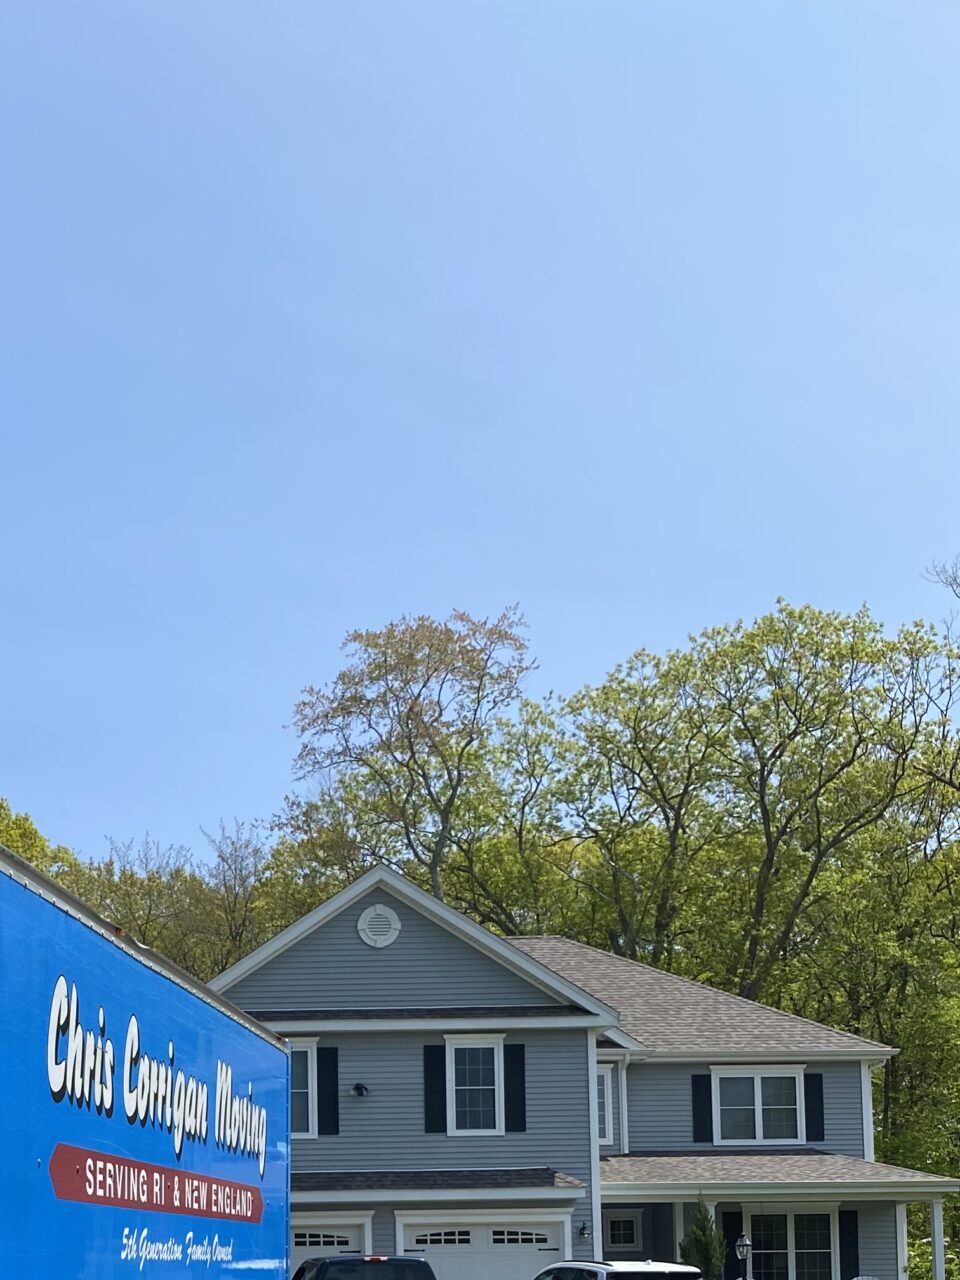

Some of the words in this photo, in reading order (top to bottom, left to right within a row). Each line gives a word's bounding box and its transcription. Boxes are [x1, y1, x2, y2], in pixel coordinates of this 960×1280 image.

[47, 974, 114, 1115] Chris
[124, 1013, 208, 1160] Corrigan
[214, 1058, 267, 1179] Moving
[85, 1157, 148, 1203] SERVING
[153, 1172, 165, 1206] RI
[173, 1175, 181, 1208] &
[185, 1178, 208, 1211] NEW
[211, 1184, 253, 1218] ENGLAND
[121, 1227, 138, 1261] 5th
[139, 1227, 183, 1272] Generation
[185, 1231, 212, 1269] Family
[212, 1233, 234, 1262] Owned
